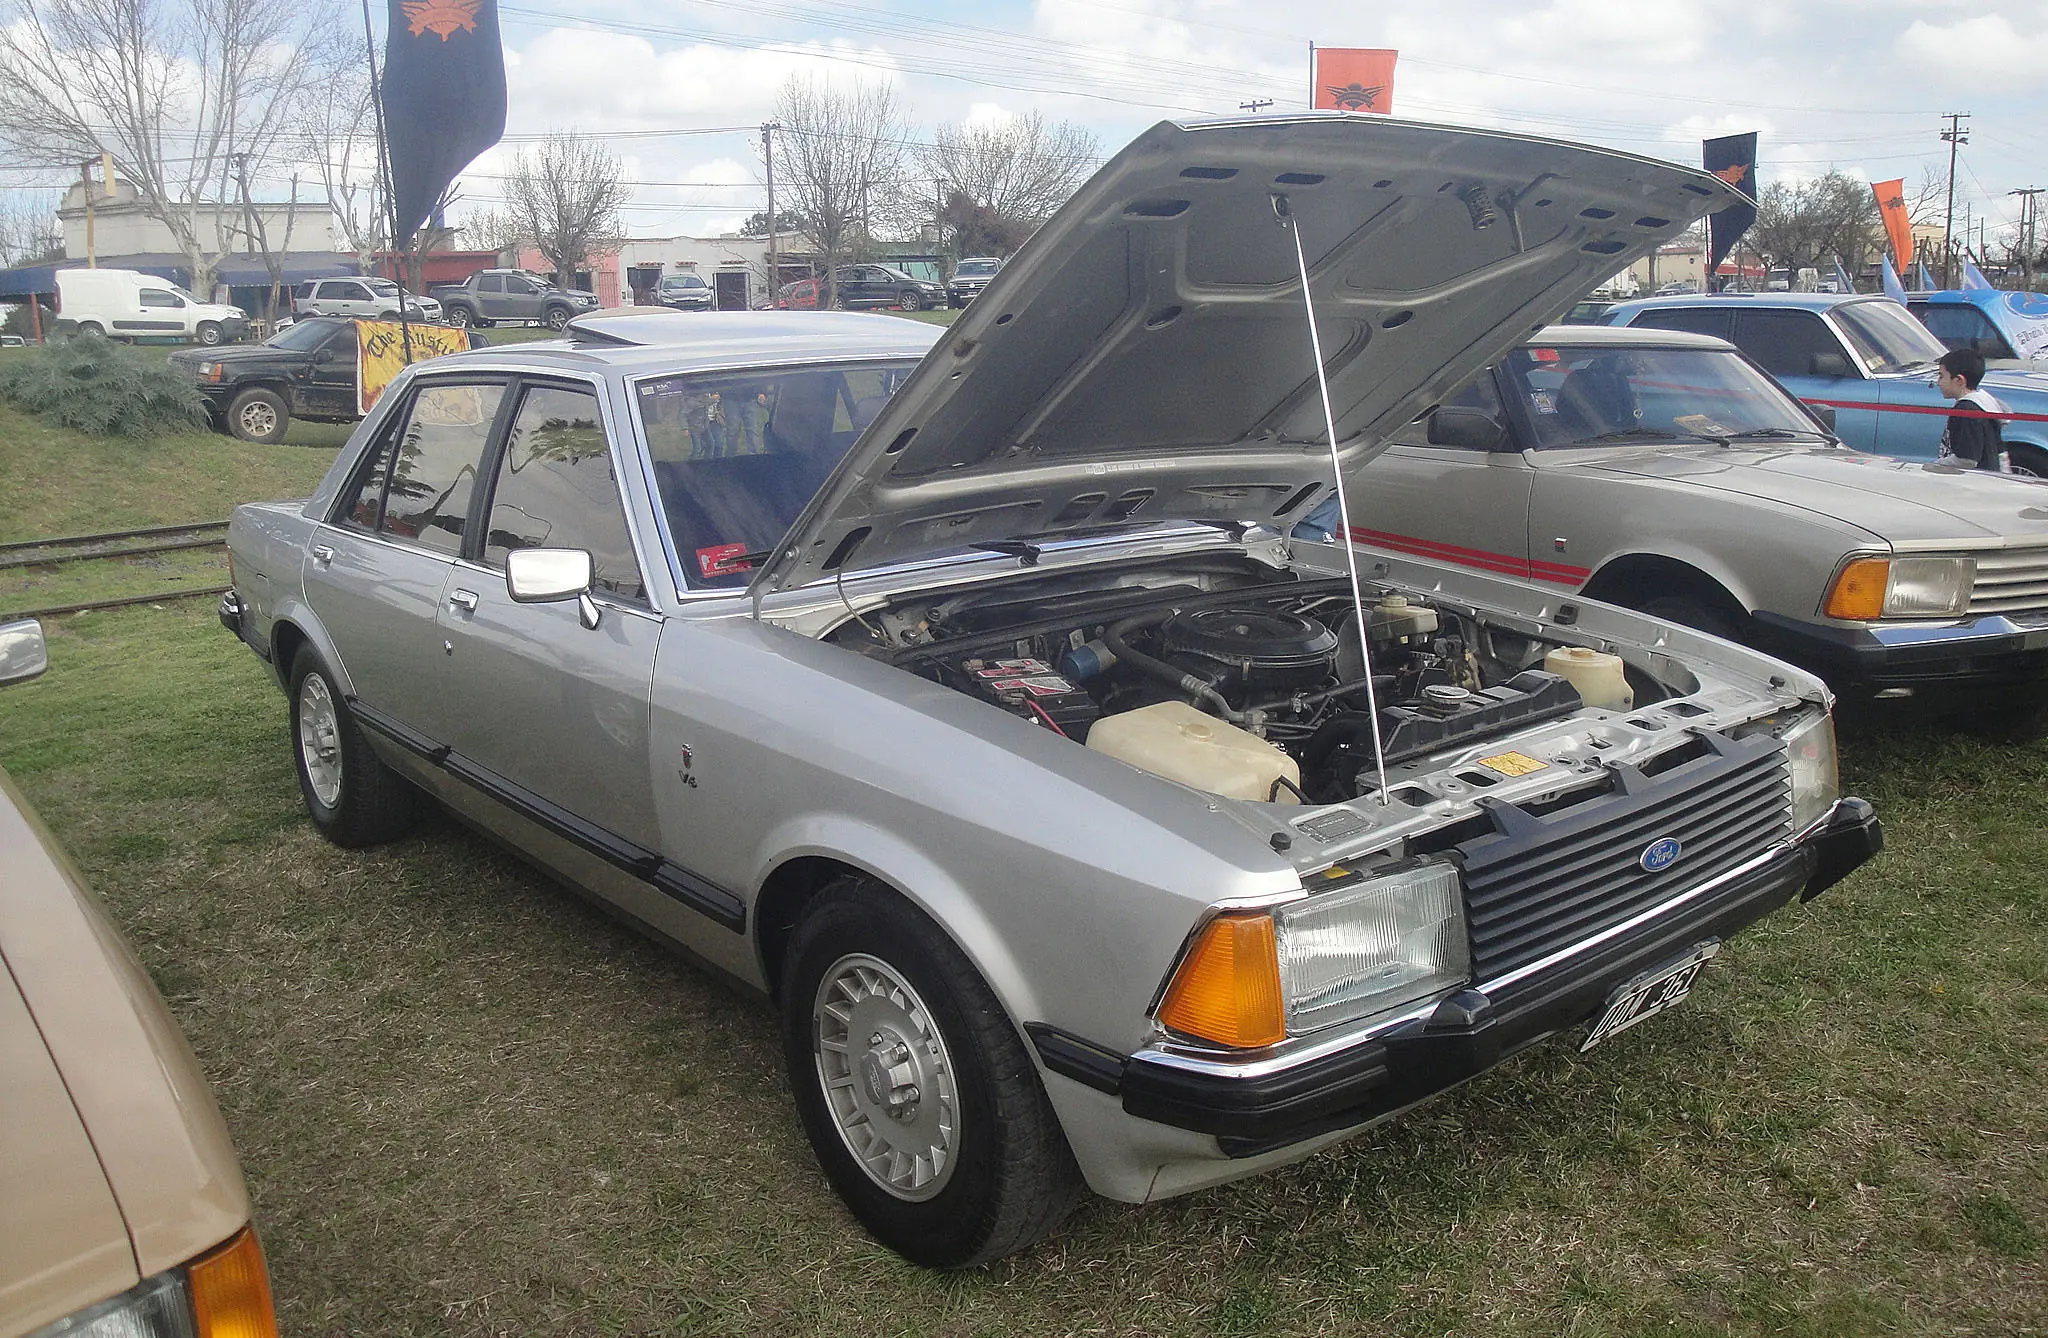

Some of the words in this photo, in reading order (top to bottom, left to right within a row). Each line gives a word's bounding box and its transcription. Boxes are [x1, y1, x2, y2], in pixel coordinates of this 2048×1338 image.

[367, 331, 395, 359] The
[1652, 841, 1674, 865] Ford
[1650, 961, 1703, 1008] 361
